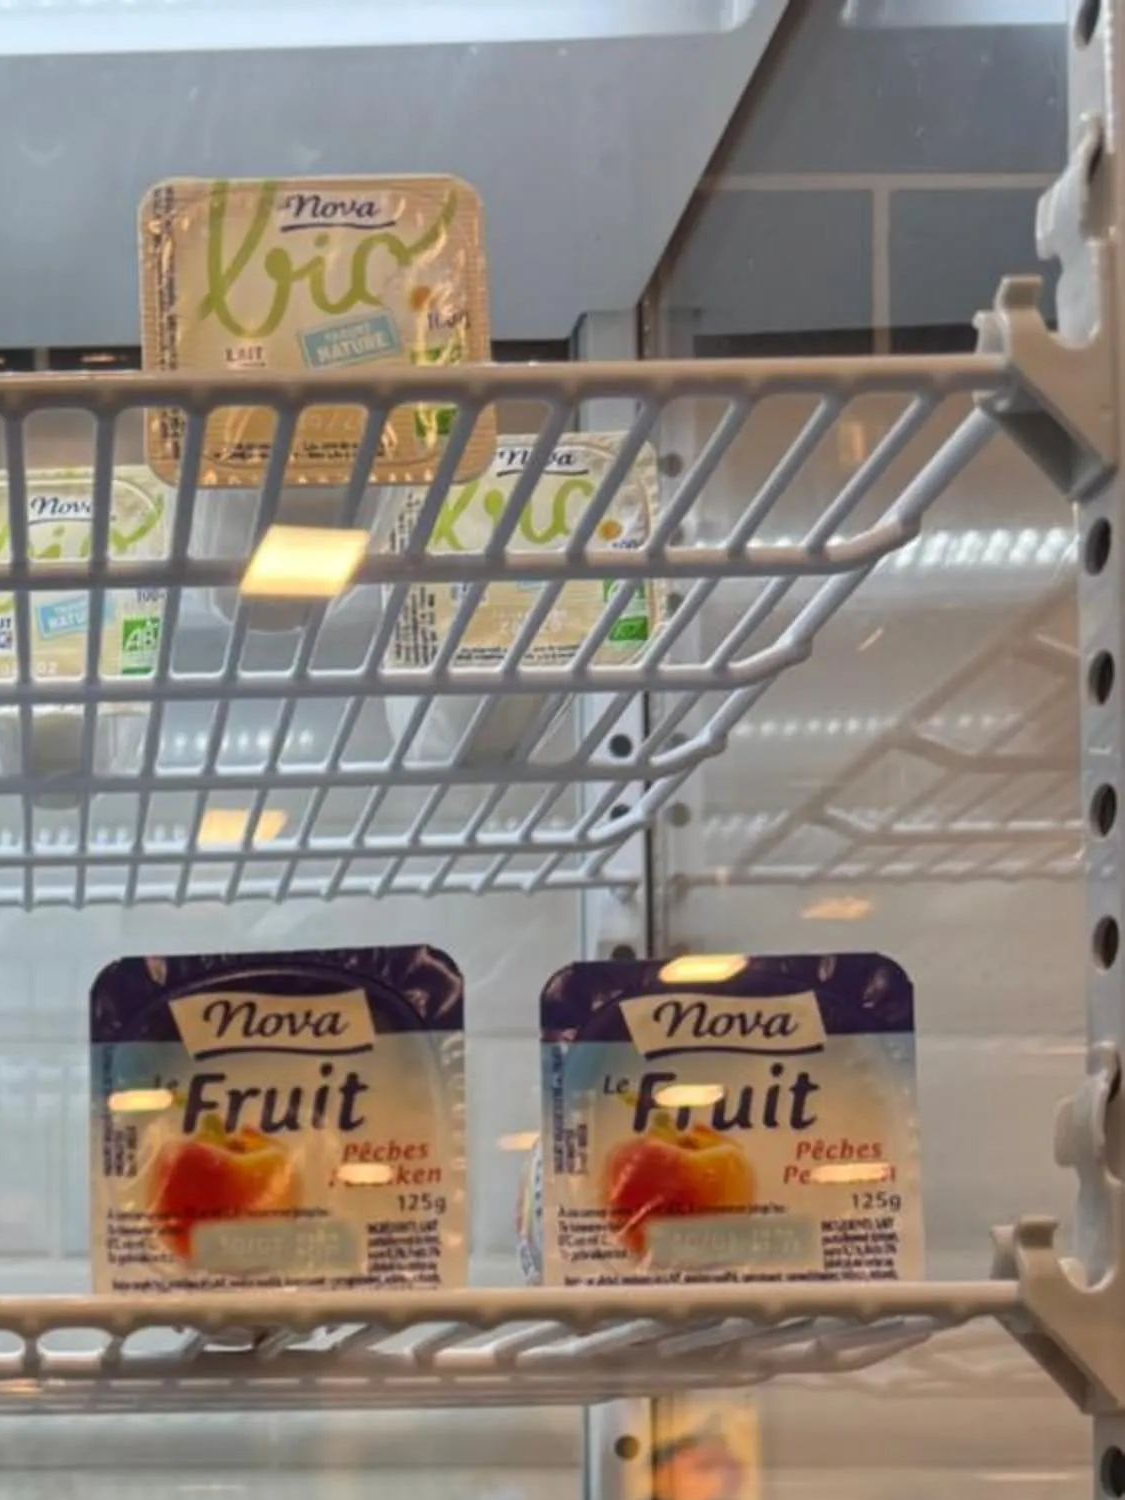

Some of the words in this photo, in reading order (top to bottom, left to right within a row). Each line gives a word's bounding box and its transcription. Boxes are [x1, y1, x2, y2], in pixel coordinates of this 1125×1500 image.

[279, 194, 378, 219] Nova
[30, 496, 93, 516] Nov
[203, 1000, 349, 1038] Nova
[653, 1001, 798, 1039] Nova
[603, 1075, 629, 1096] Le
[182, 1063, 369, 1133] Fruit
[796, 1138, 882, 1161] Pêches
[398, 1193, 447, 1214] 125g
[851, 1191, 902, 1212] 125g
